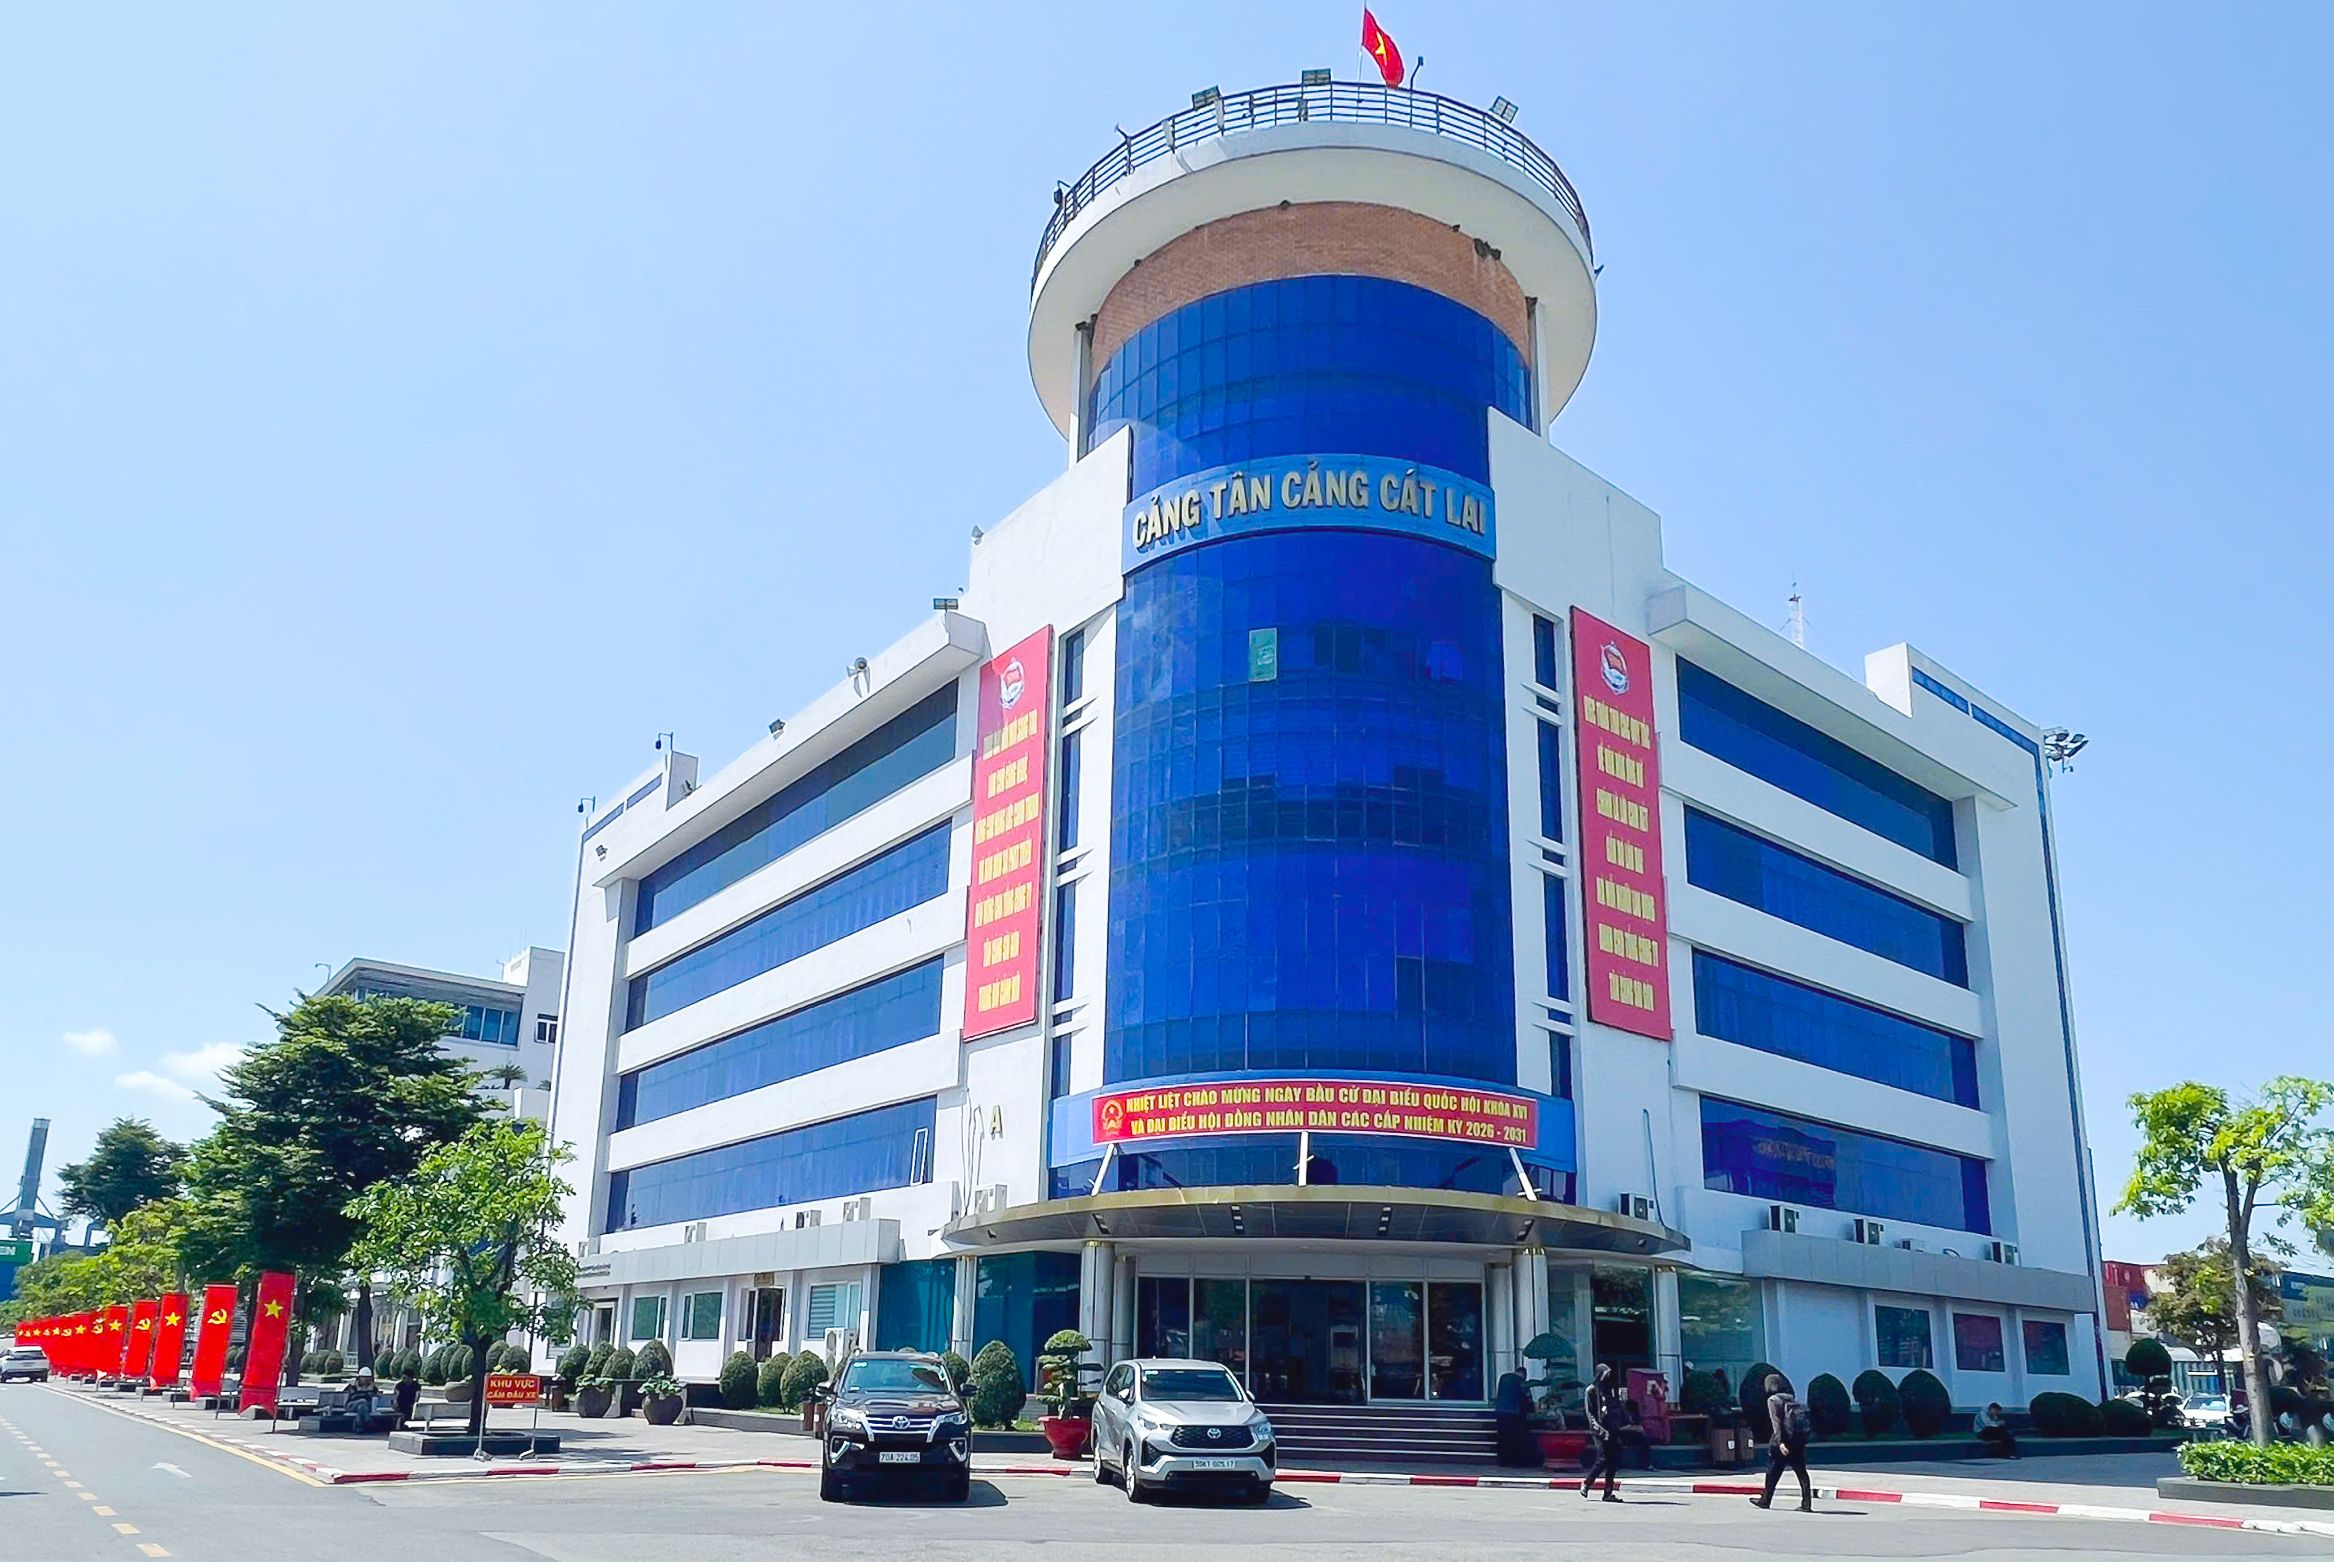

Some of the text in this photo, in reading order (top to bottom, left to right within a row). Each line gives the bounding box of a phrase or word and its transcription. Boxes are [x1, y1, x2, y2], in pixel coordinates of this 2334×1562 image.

[1210, 471, 1272, 519] TÂN
[1281, 461, 1369, 509] CẢNG
[1380, 468, 1437, 519] CÁT
[1126, 1094, 1156, 1113] NHIỆT
[1158, 1091, 1181, 1111] LIỆT
[1221, 1086, 1261, 1104] MỪNG
[1264, 1085, 1302, 1103] NGÀY
[1305, 1083, 1335, 1103] BẦU
[1338, 1084, 1360, 1103] CỬ
[1423, 1090, 1458, 1110] QUỐC
[1460, 1095, 1480, 1115] HỘI
[1198, 1111, 1221, 1131] HỘI
[1266, 1108, 1304, 1127] NHÂN
[1308, 1108, 1337, 1127] DÂN
[1341, 1110, 1370, 1128] CÁC
[1373, 1109, 1400, 1129] CẤP
[1404, 1114, 1444, 1134] NHIỆM
[1465, 1121, 1495, 1138] 2026
[1503, 1126, 1527, 1143] 2031
[490, 1379, 535, 1389] KHU VỰC
[525, 1391, 537, 1399] XE
